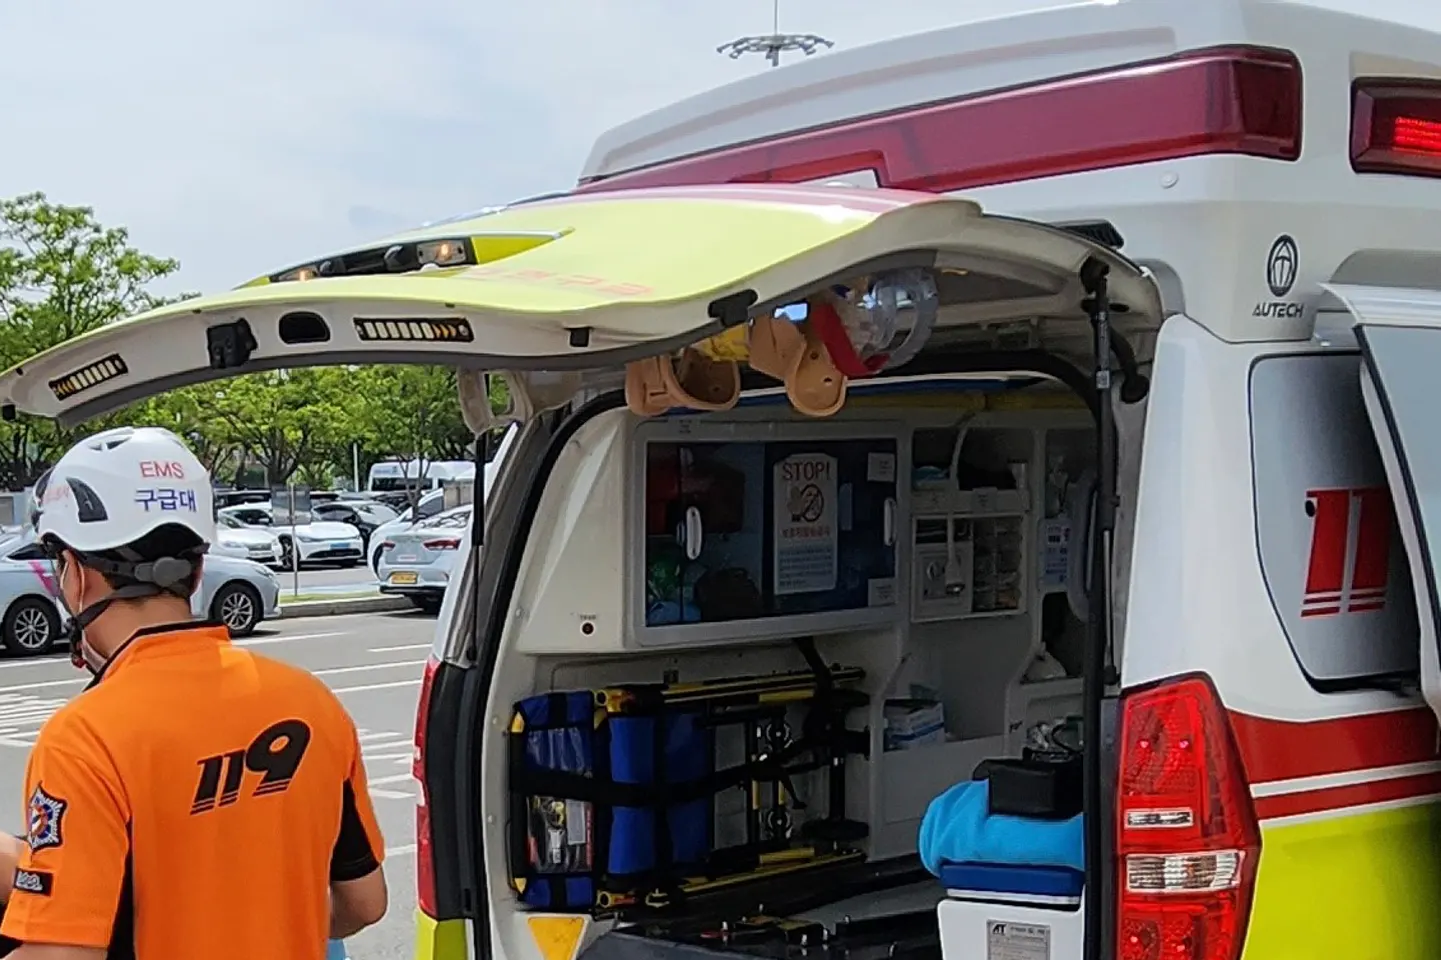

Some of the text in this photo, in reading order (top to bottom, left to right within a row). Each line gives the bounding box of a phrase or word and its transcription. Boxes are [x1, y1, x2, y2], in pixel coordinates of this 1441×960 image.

[1252, 301, 1305, 319] AUTECH
[139, 460, 185, 480] EMS
[782, 460, 831, 481] STOP!
[134, 486, 198, 513] 구급대
[189, 717, 312, 816] 119
